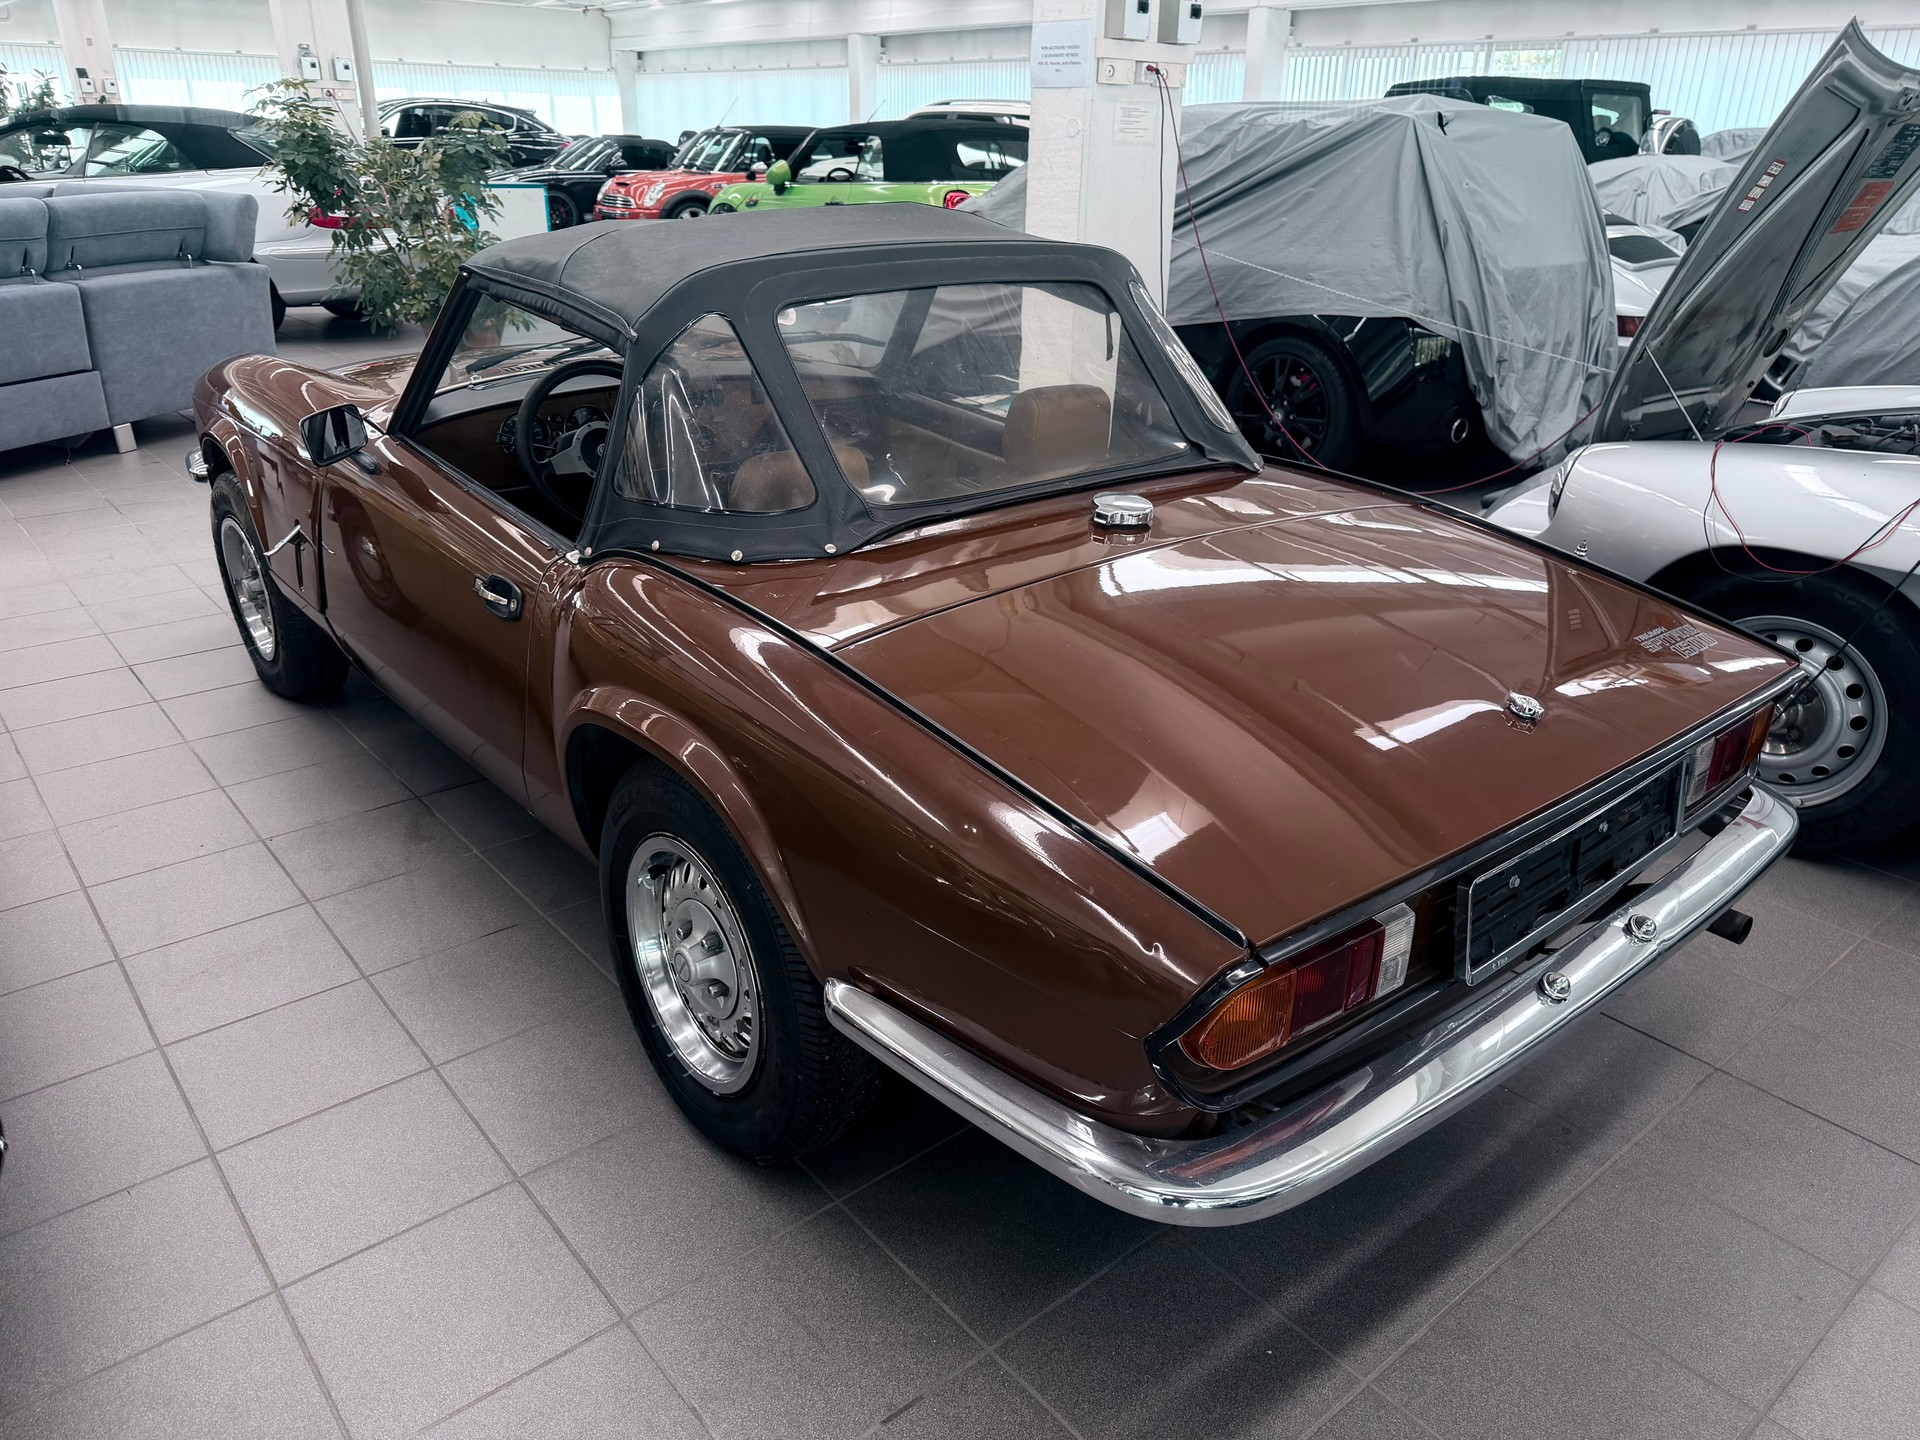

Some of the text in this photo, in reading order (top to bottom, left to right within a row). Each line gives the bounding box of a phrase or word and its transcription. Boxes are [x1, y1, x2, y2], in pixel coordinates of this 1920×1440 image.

[1634, 626, 1668, 642] TRIUMPH
[1641, 624, 1700, 653] SPITFIRE
[1669, 632, 1718, 659] 1500
